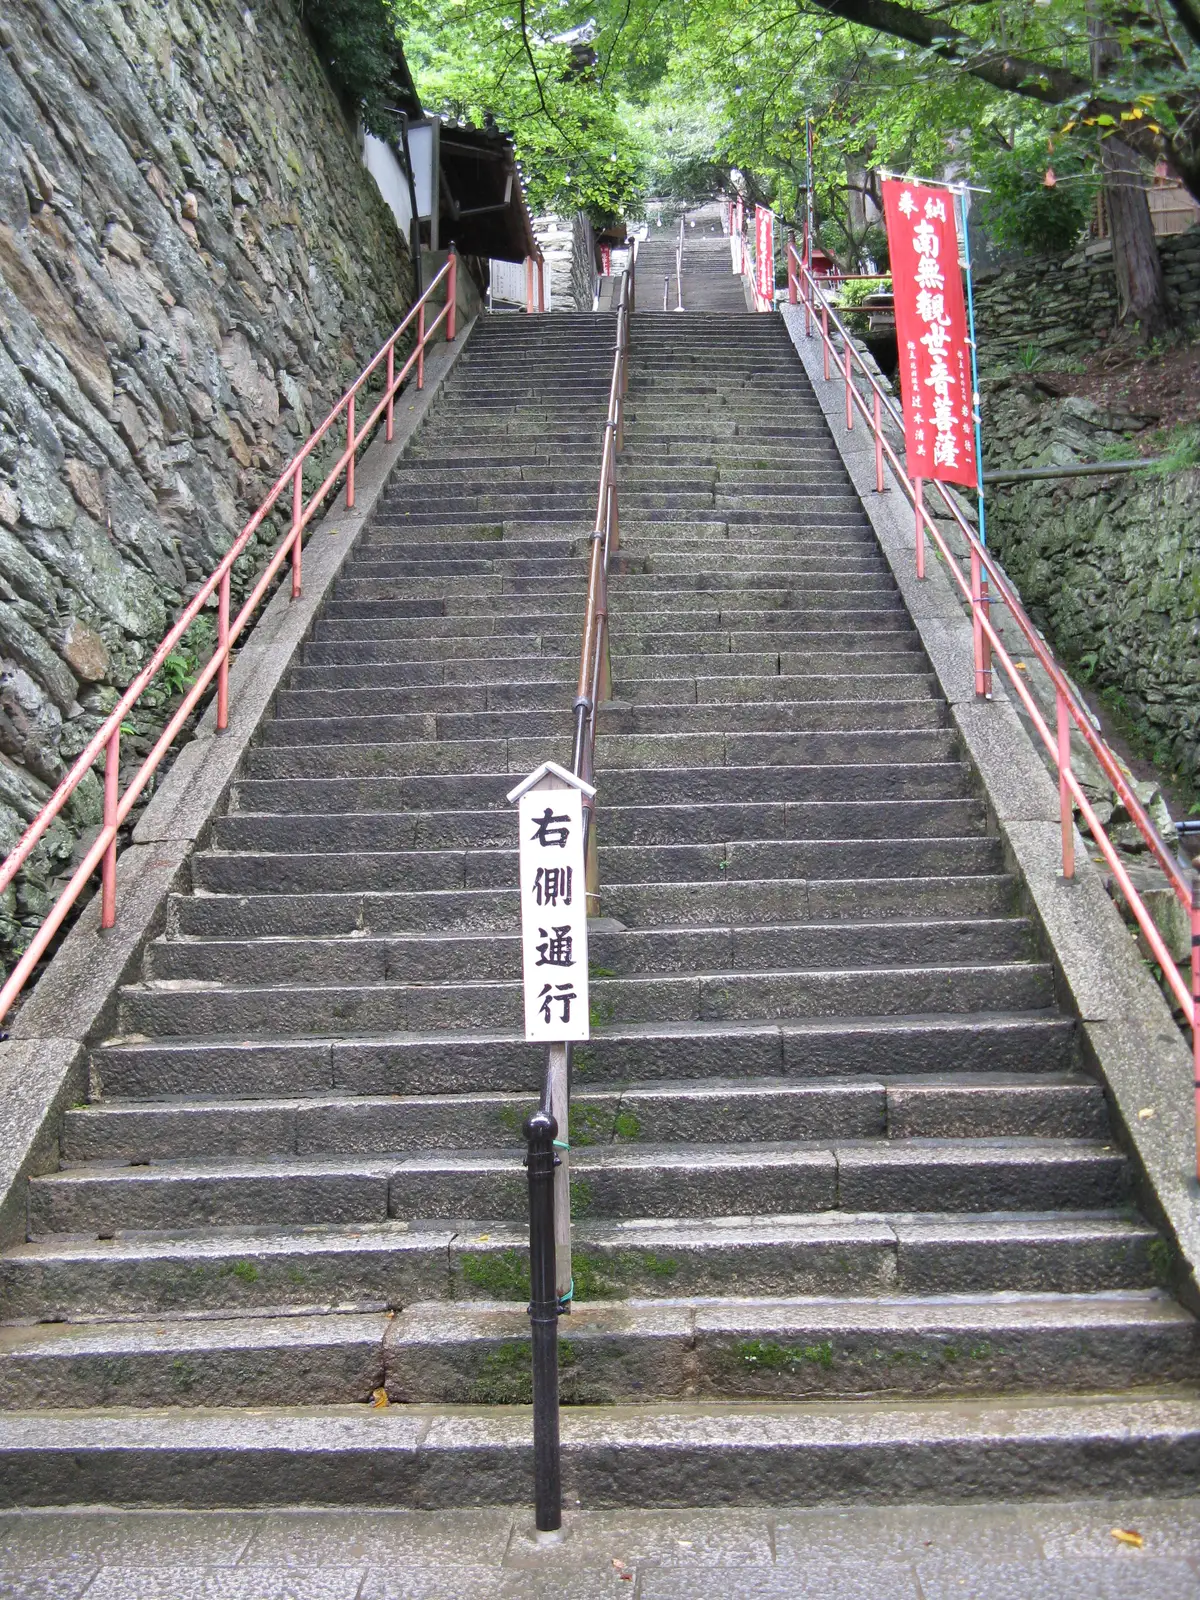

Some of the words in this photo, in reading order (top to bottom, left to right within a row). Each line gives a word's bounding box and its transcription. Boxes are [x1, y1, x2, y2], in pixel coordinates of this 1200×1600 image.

[898, 190, 947, 223] 奉納
[912, 219, 960, 468] 南無観世音菩薩
[530, 807, 577, 1024] 右側通行
